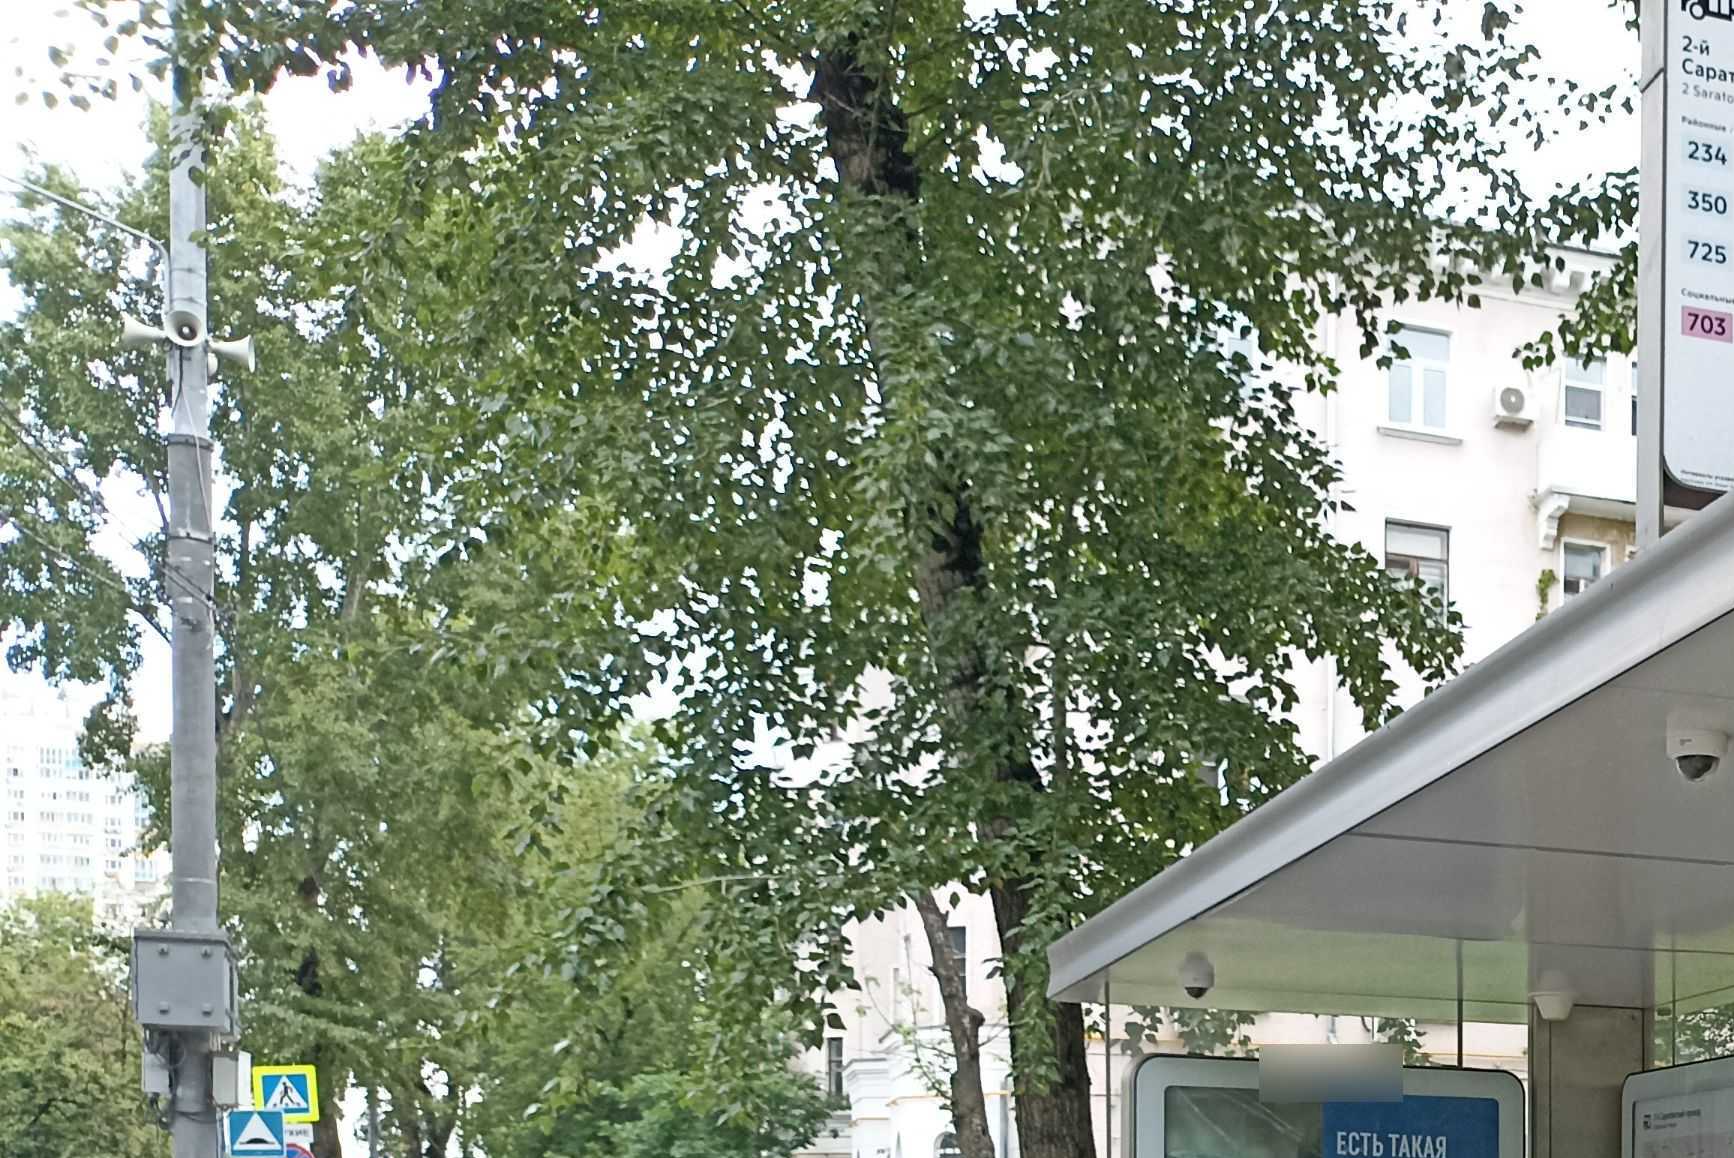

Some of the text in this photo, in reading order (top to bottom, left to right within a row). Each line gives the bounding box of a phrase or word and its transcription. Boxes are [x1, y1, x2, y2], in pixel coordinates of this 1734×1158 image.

[1682, 35, 1710, 56] 2-й
[1682, 82, 1690, 96] 2
[1688, 140, 1728, 165] 234
[1688, 191, 1728, 215] 350
[1688, 240, 1727, 265] 725
[1688, 312, 1726, 337] 703
[1336, 1131, 1384, 1157] ЕСТЬ
